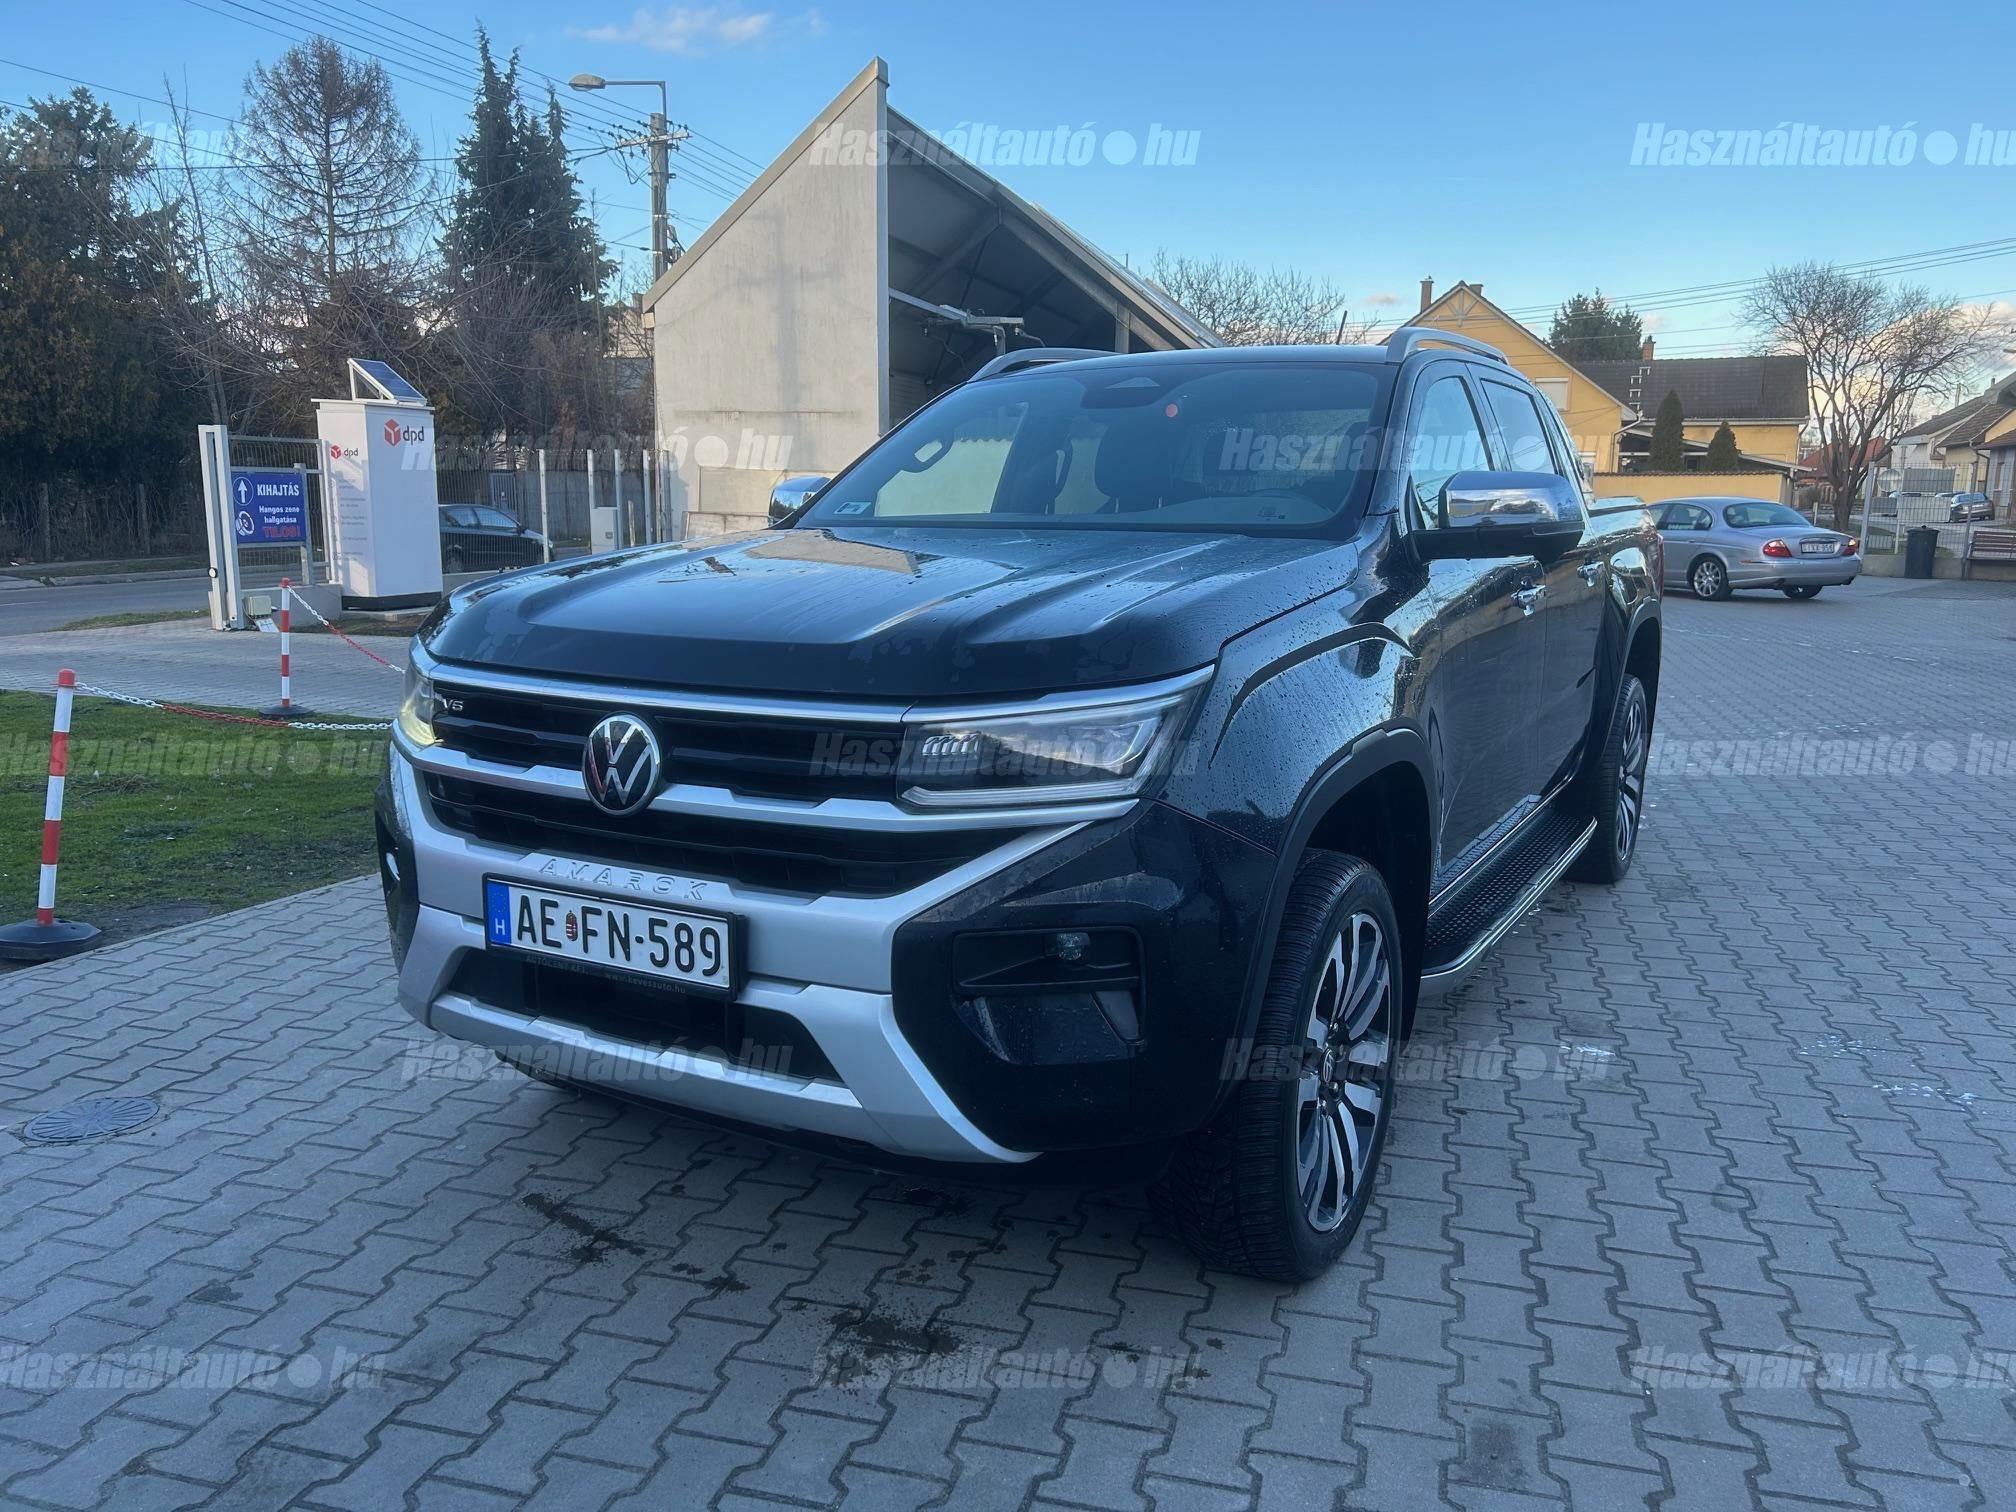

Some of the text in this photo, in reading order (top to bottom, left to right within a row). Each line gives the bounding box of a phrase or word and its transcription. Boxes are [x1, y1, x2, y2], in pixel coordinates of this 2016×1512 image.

[403, 425, 425, 445] dpd
[343, 447, 359, 458] dpd
[257, 482, 300, 496] KIHAJTÁS
[264, 516, 297, 525] hallgatása
[539, 859, 709, 901] AMAROK
[494, 918, 506, 936] H
